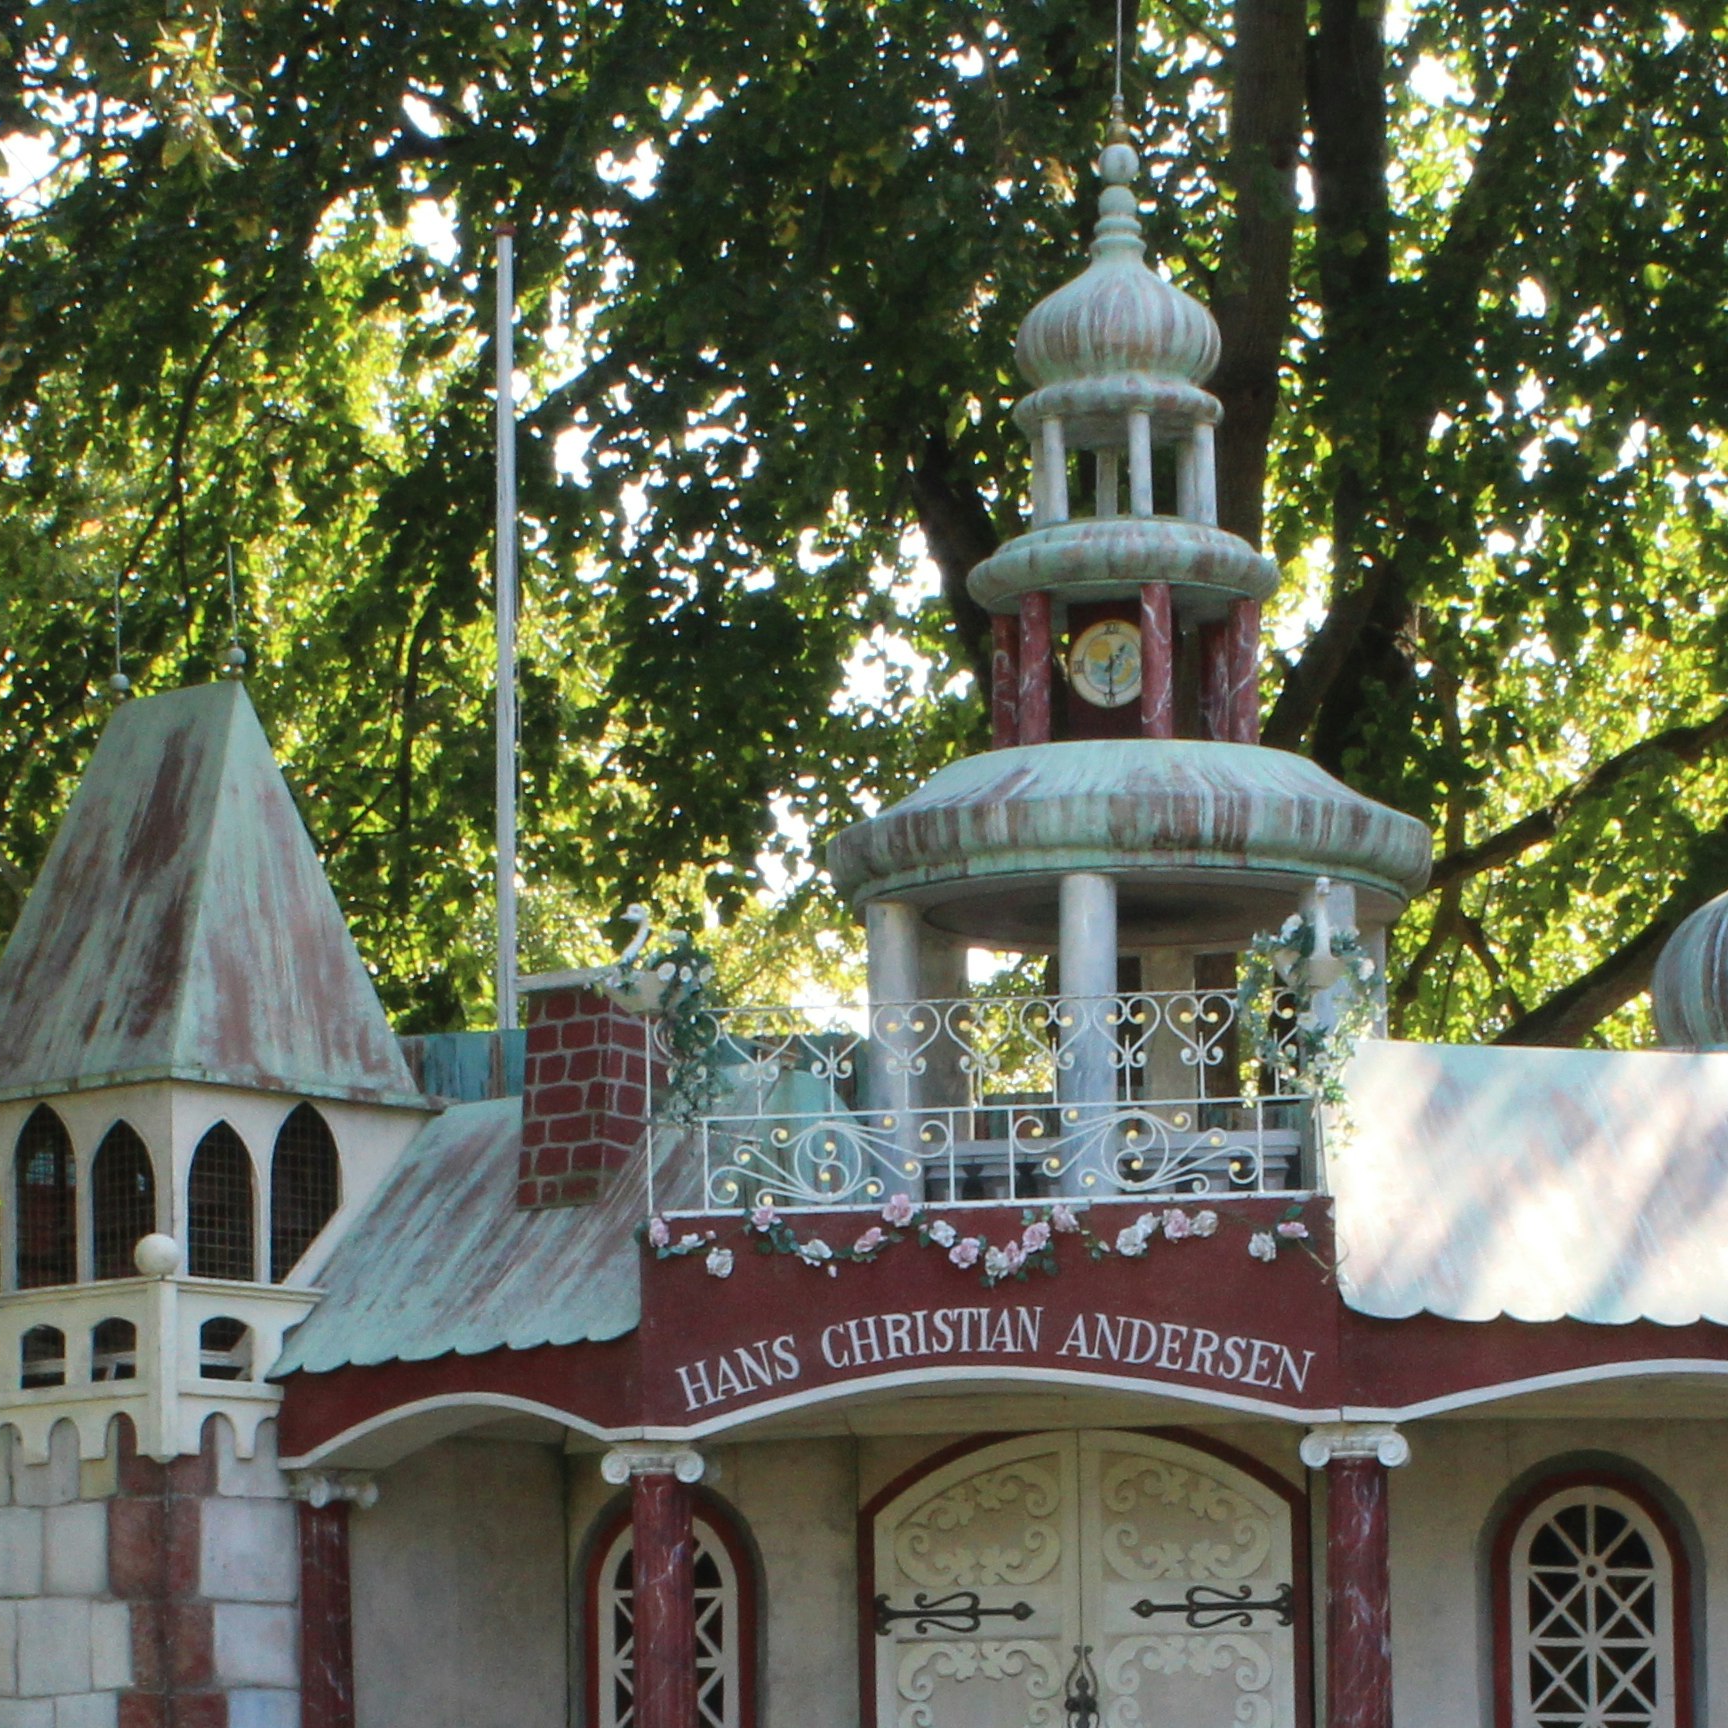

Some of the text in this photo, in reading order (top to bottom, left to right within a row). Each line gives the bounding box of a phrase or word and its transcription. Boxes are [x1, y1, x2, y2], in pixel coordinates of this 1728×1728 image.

[675, 1306, 1316, 1412] HANS CHRISTIAN ANDERSEN
